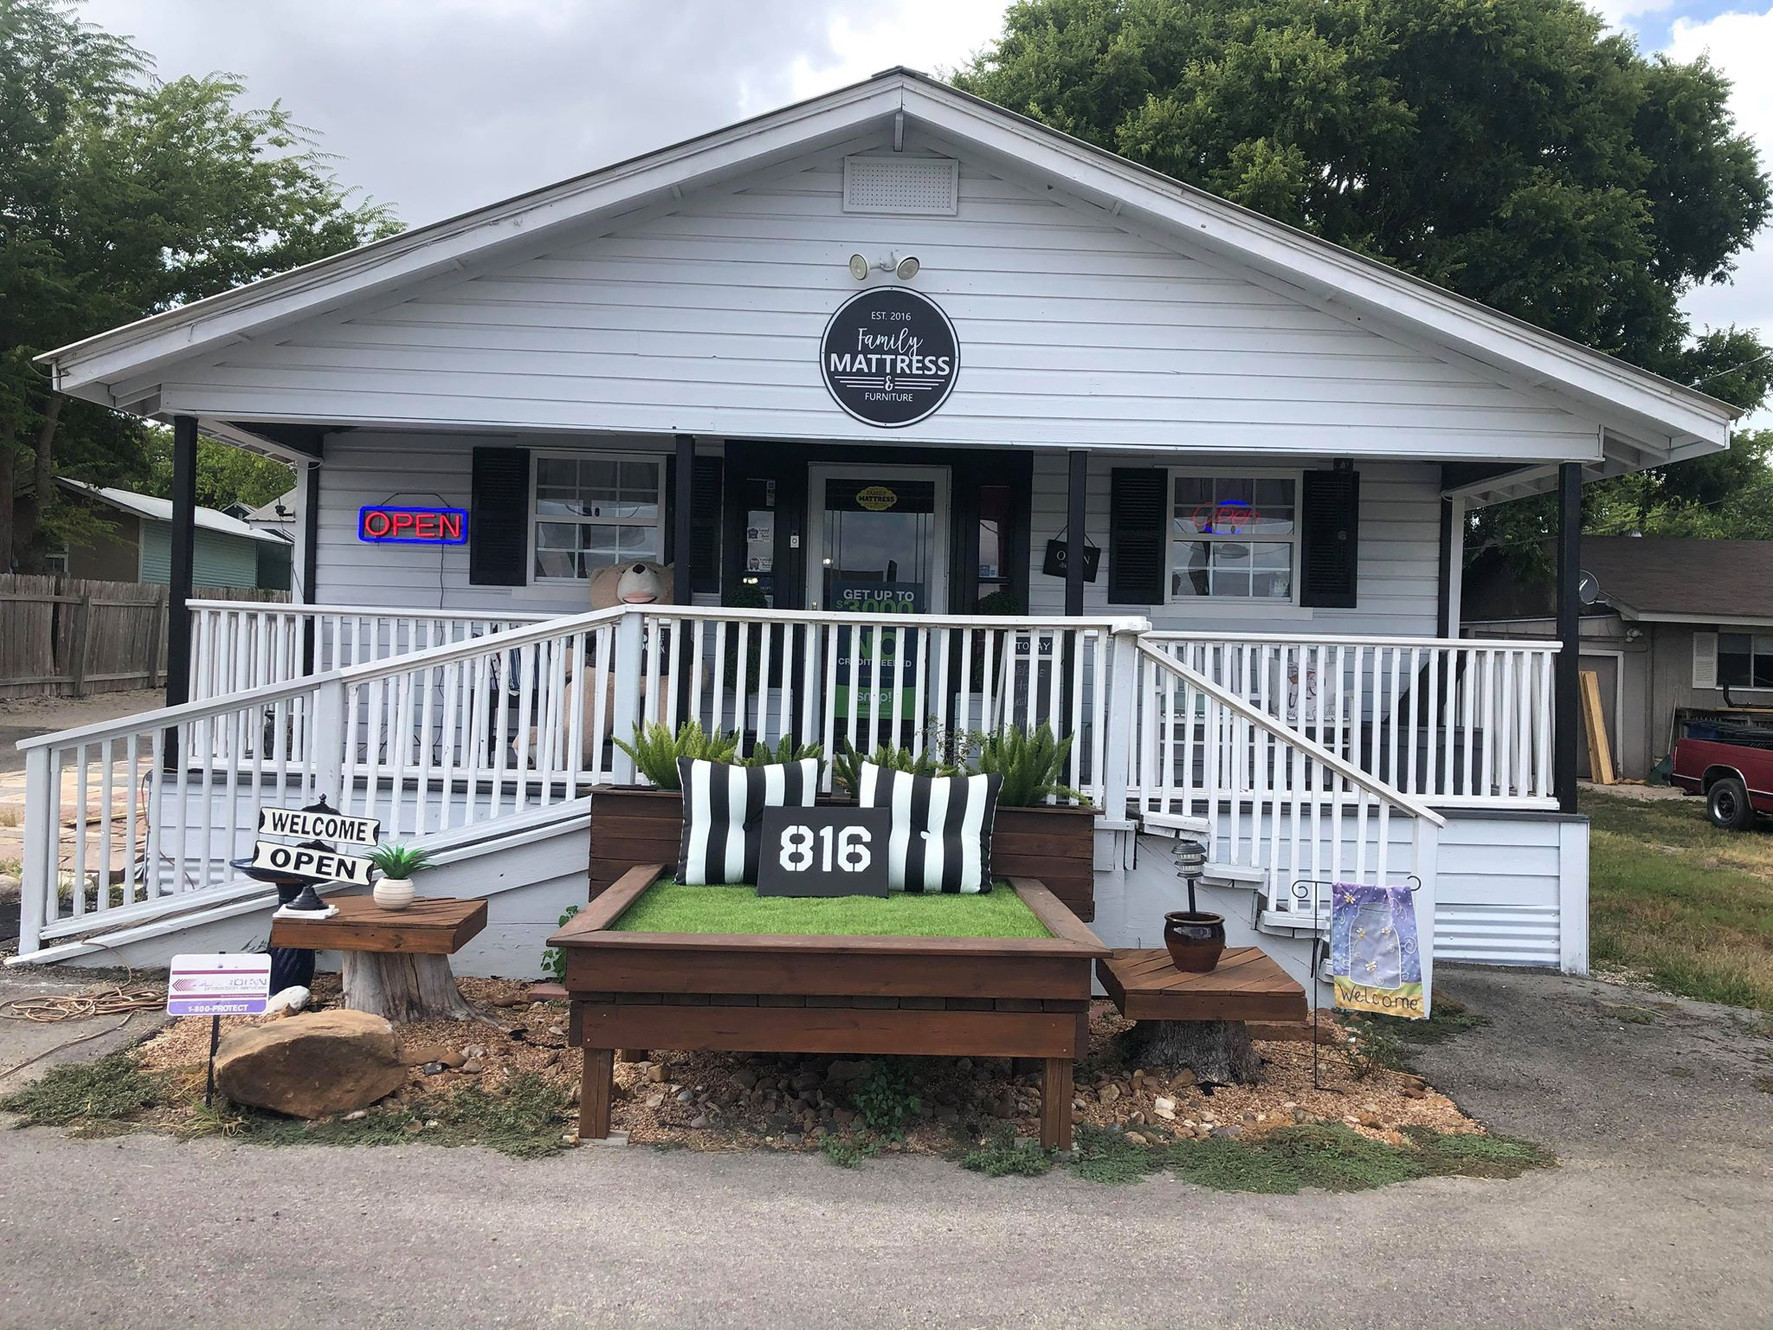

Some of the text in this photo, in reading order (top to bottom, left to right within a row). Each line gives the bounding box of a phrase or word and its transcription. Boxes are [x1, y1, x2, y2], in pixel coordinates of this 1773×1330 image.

[871, 311, 912, 321] EST. 2016
[857, 327, 924, 359] Family
[830, 353, 950, 375] MATTRESS
[885, 375, 894, 391] &
[864, 392, 914, 402] FURNITURE
[364, 511, 460, 538] OPEN
[843, 589, 915, 602] GET UP TO
[1016, 641, 1051, 651] TOAY
[838, 657, 873, 666] CRDIT
[857, 691, 893, 705] snp!
[272, 811, 368, 842] WELCOME
[779, 825, 872, 872] 816
[270, 848, 357, 880] OPEN
[1338, 984, 1418, 1011] Welcome
[188, 1004, 249, 1013] 1-800-PROTECT
